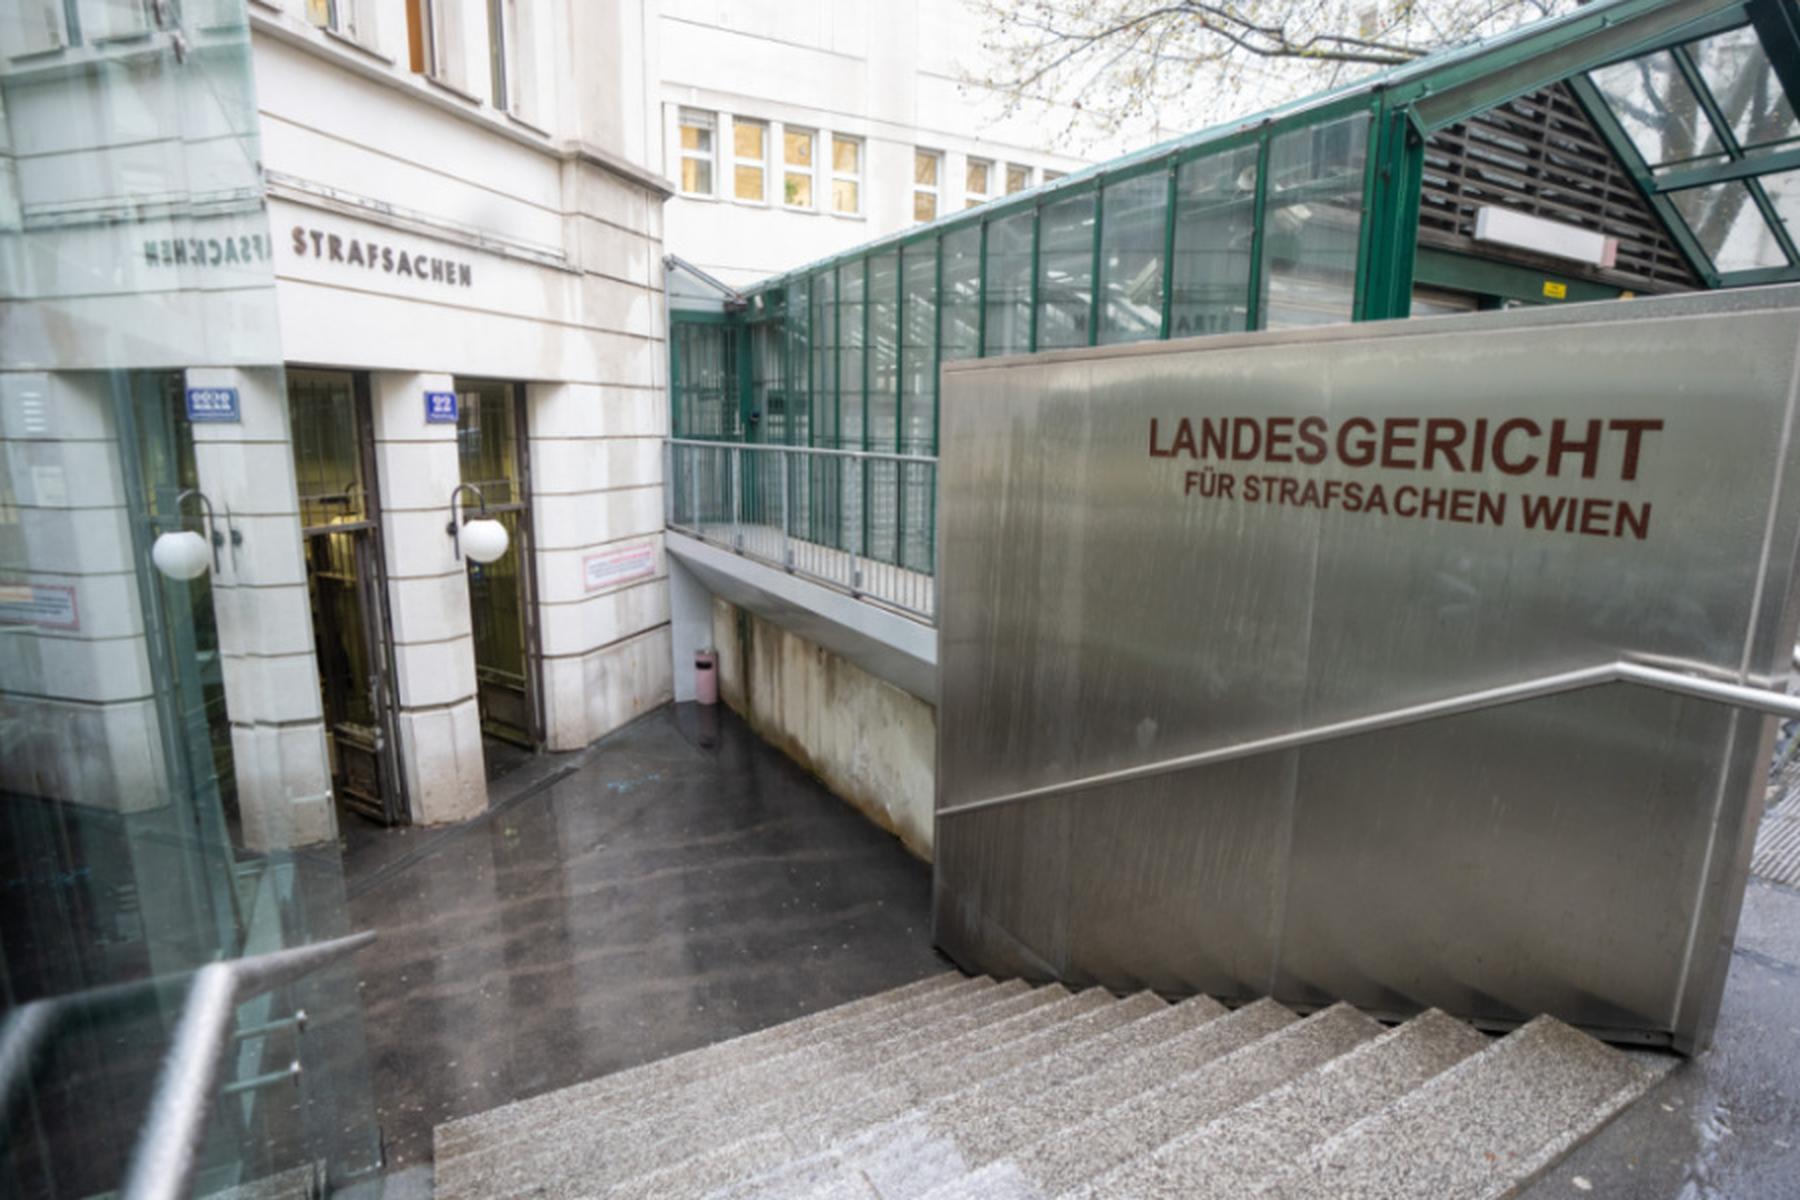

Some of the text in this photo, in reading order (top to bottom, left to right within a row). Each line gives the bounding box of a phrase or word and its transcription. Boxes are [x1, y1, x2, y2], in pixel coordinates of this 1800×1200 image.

[291, 226, 472, 287] STRAFSACHEN
[432, 395, 452, 412] 22
[1149, 415, 1664, 481] LANDESGERICHT
[1184, 466, 1653, 541] FÜR STRAFSACHEN WIEN
